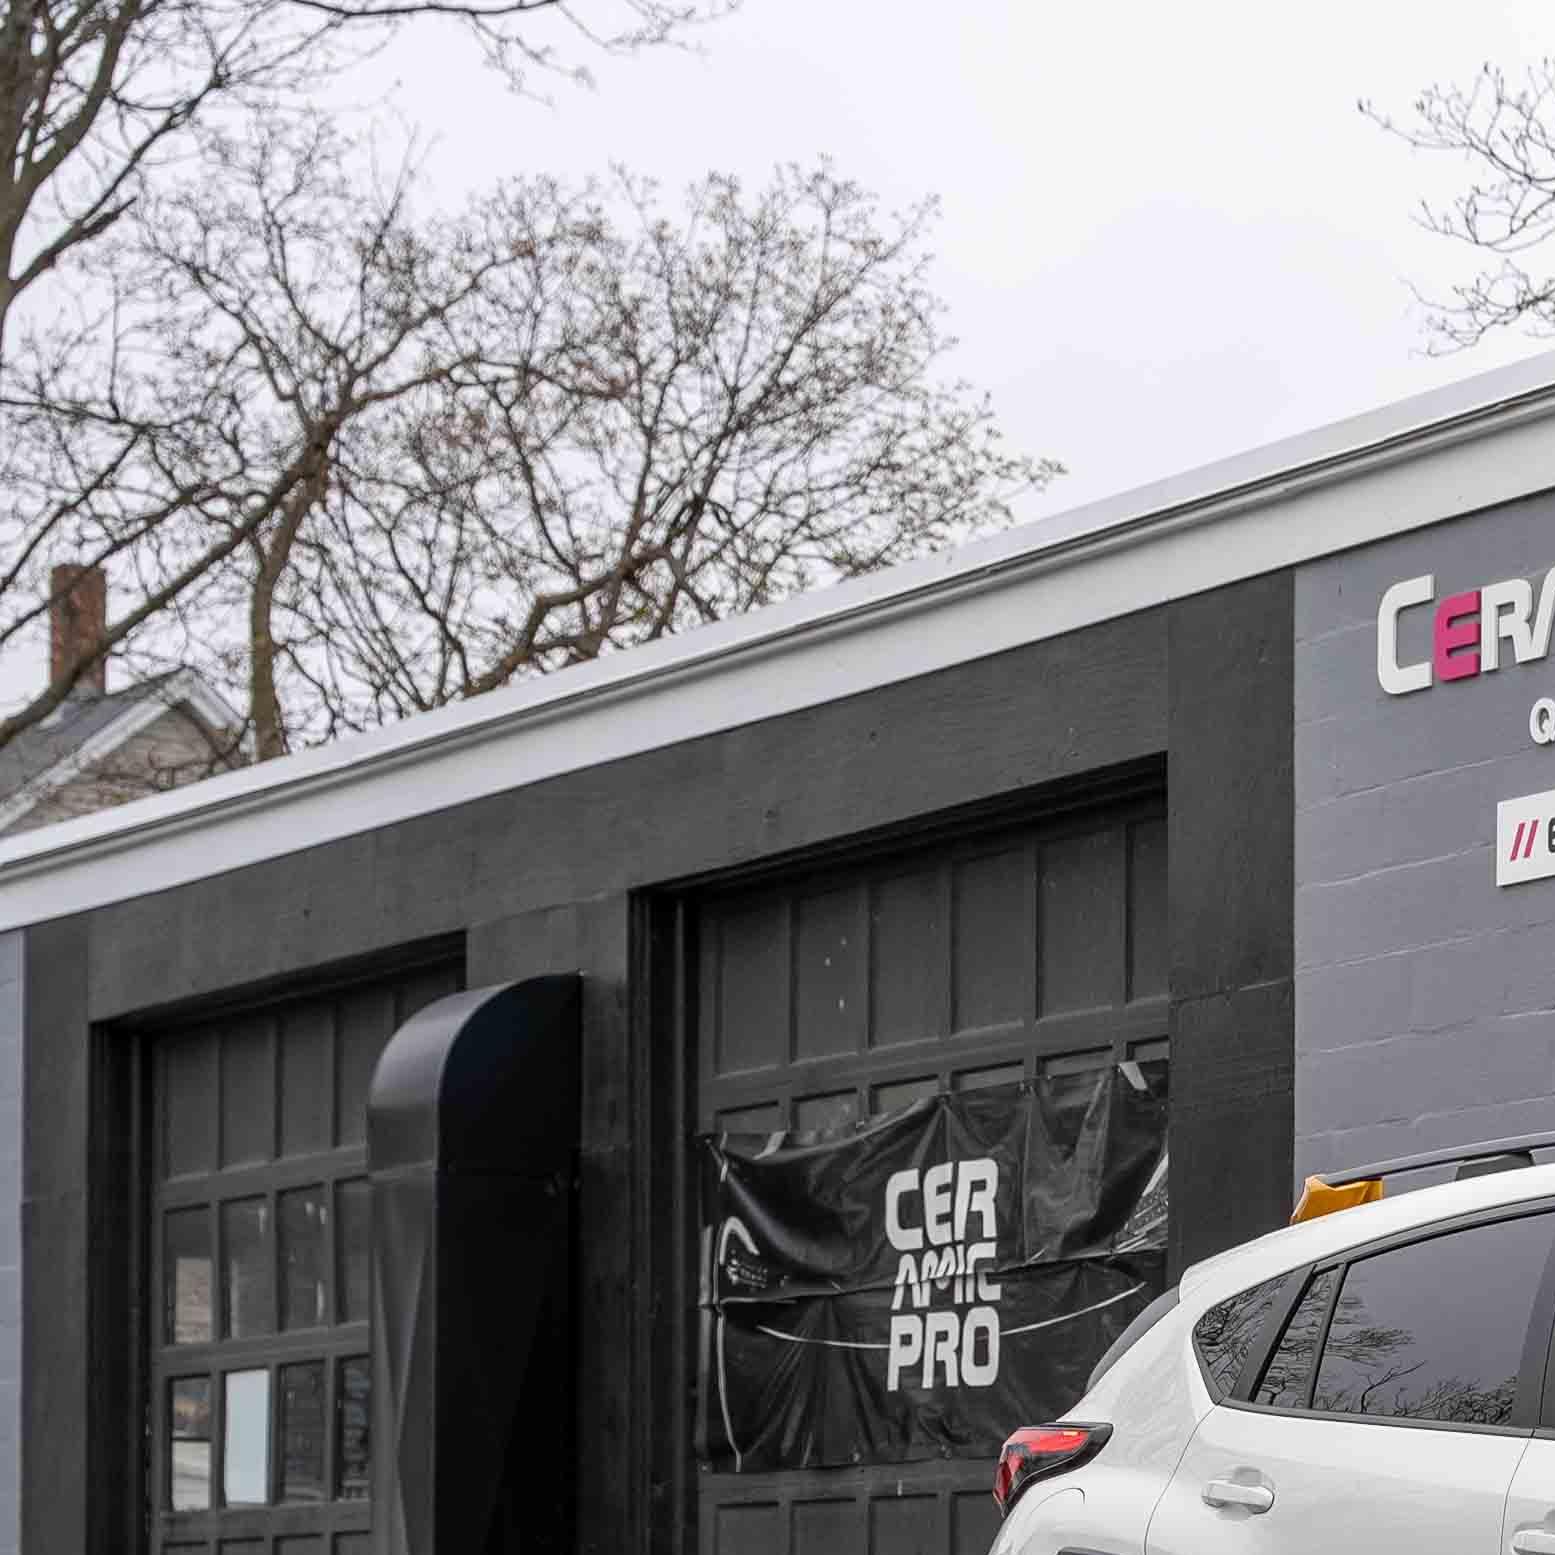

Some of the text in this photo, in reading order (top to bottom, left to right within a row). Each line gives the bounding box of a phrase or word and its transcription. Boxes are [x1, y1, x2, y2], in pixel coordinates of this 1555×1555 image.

[885, 1158, 999, 1251] CER
[891, 1242, 1001, 1311] AMIC
[887, 1306, 1001, 1392] PRO
